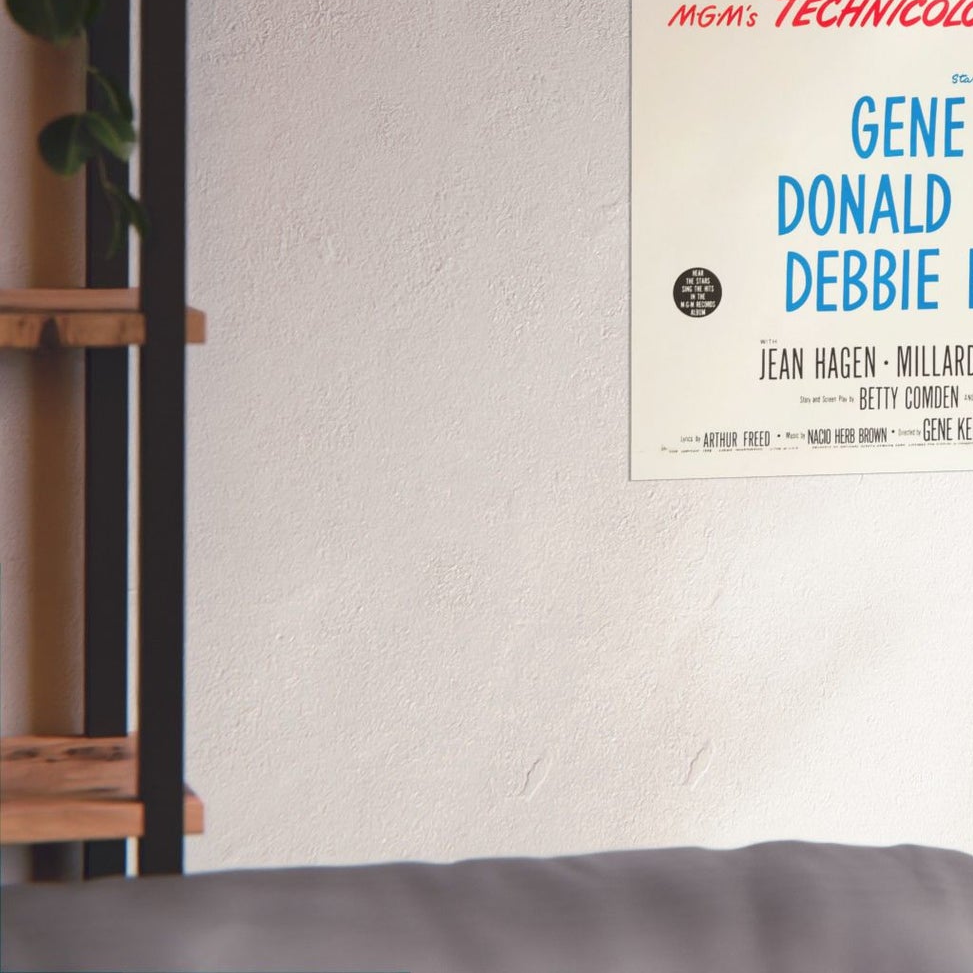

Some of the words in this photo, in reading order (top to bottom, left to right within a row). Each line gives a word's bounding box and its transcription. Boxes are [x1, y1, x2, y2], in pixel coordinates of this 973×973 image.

[852, 96, 965, 159] GENE
[778, 174, 951, 236] DONALD
[786, 249, 939, 312] DEBBIE
[760, 348, 803, 380] JEAN
[816, 347, 875, 379] HAGEN
[860, 387, 898, 410] BETTY
[906, 386, 958, 409] COMDEN
[704, 432, 737, 447] ARTHUR
[744, 431, 769, 446] FREED
[808, 429, 831, 444] NACIO
[835, 429, 855, 443] HERB
[859, 428, 886, 443] BROWN
[924, 418, 952, 441] GENE
